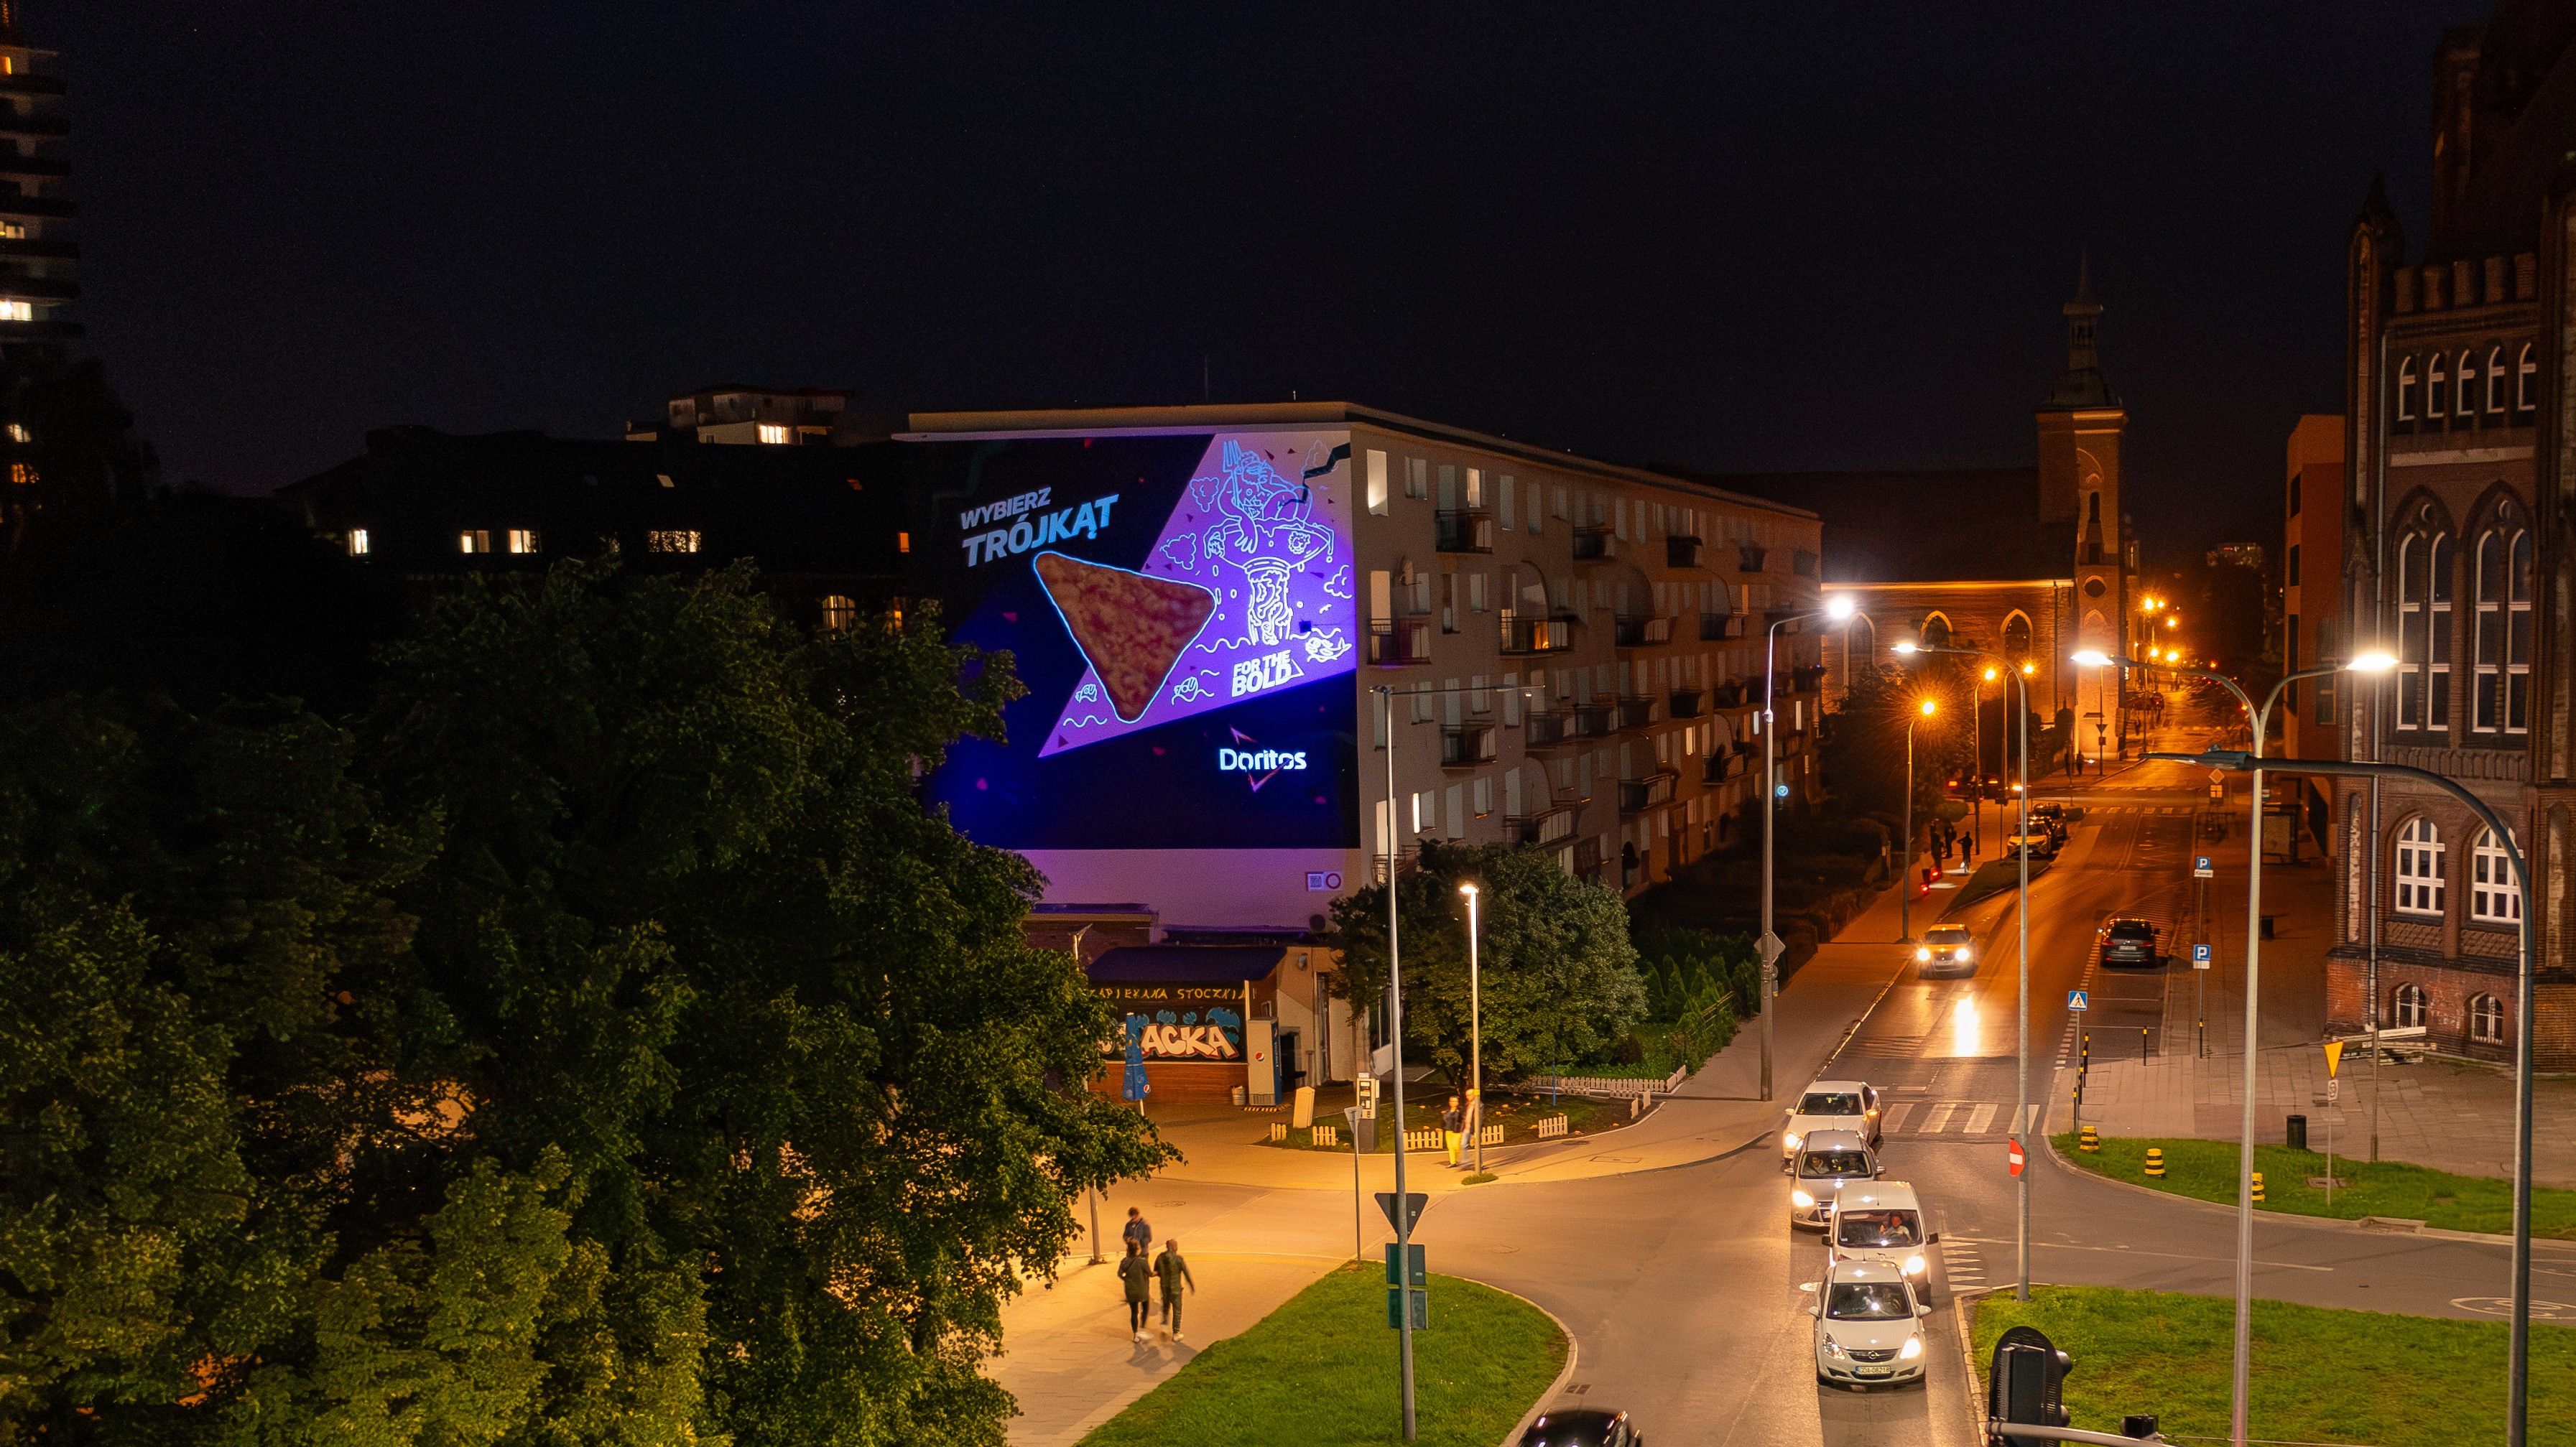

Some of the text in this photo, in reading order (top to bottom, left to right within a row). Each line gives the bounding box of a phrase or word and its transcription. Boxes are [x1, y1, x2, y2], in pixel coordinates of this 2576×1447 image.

[961, 487, 1051, 529] WYBIERZ
[962, 494, 1119, 567] TRÓJKĄT
[1233, 649, 1292, 678] FOR THE
[1231, 661, 1292, 697] BOLD
[1220, 748, 1307, 771] Doritos
[2199, 858, 2208, 868] P
[2197, 946, 2207, 959] P
